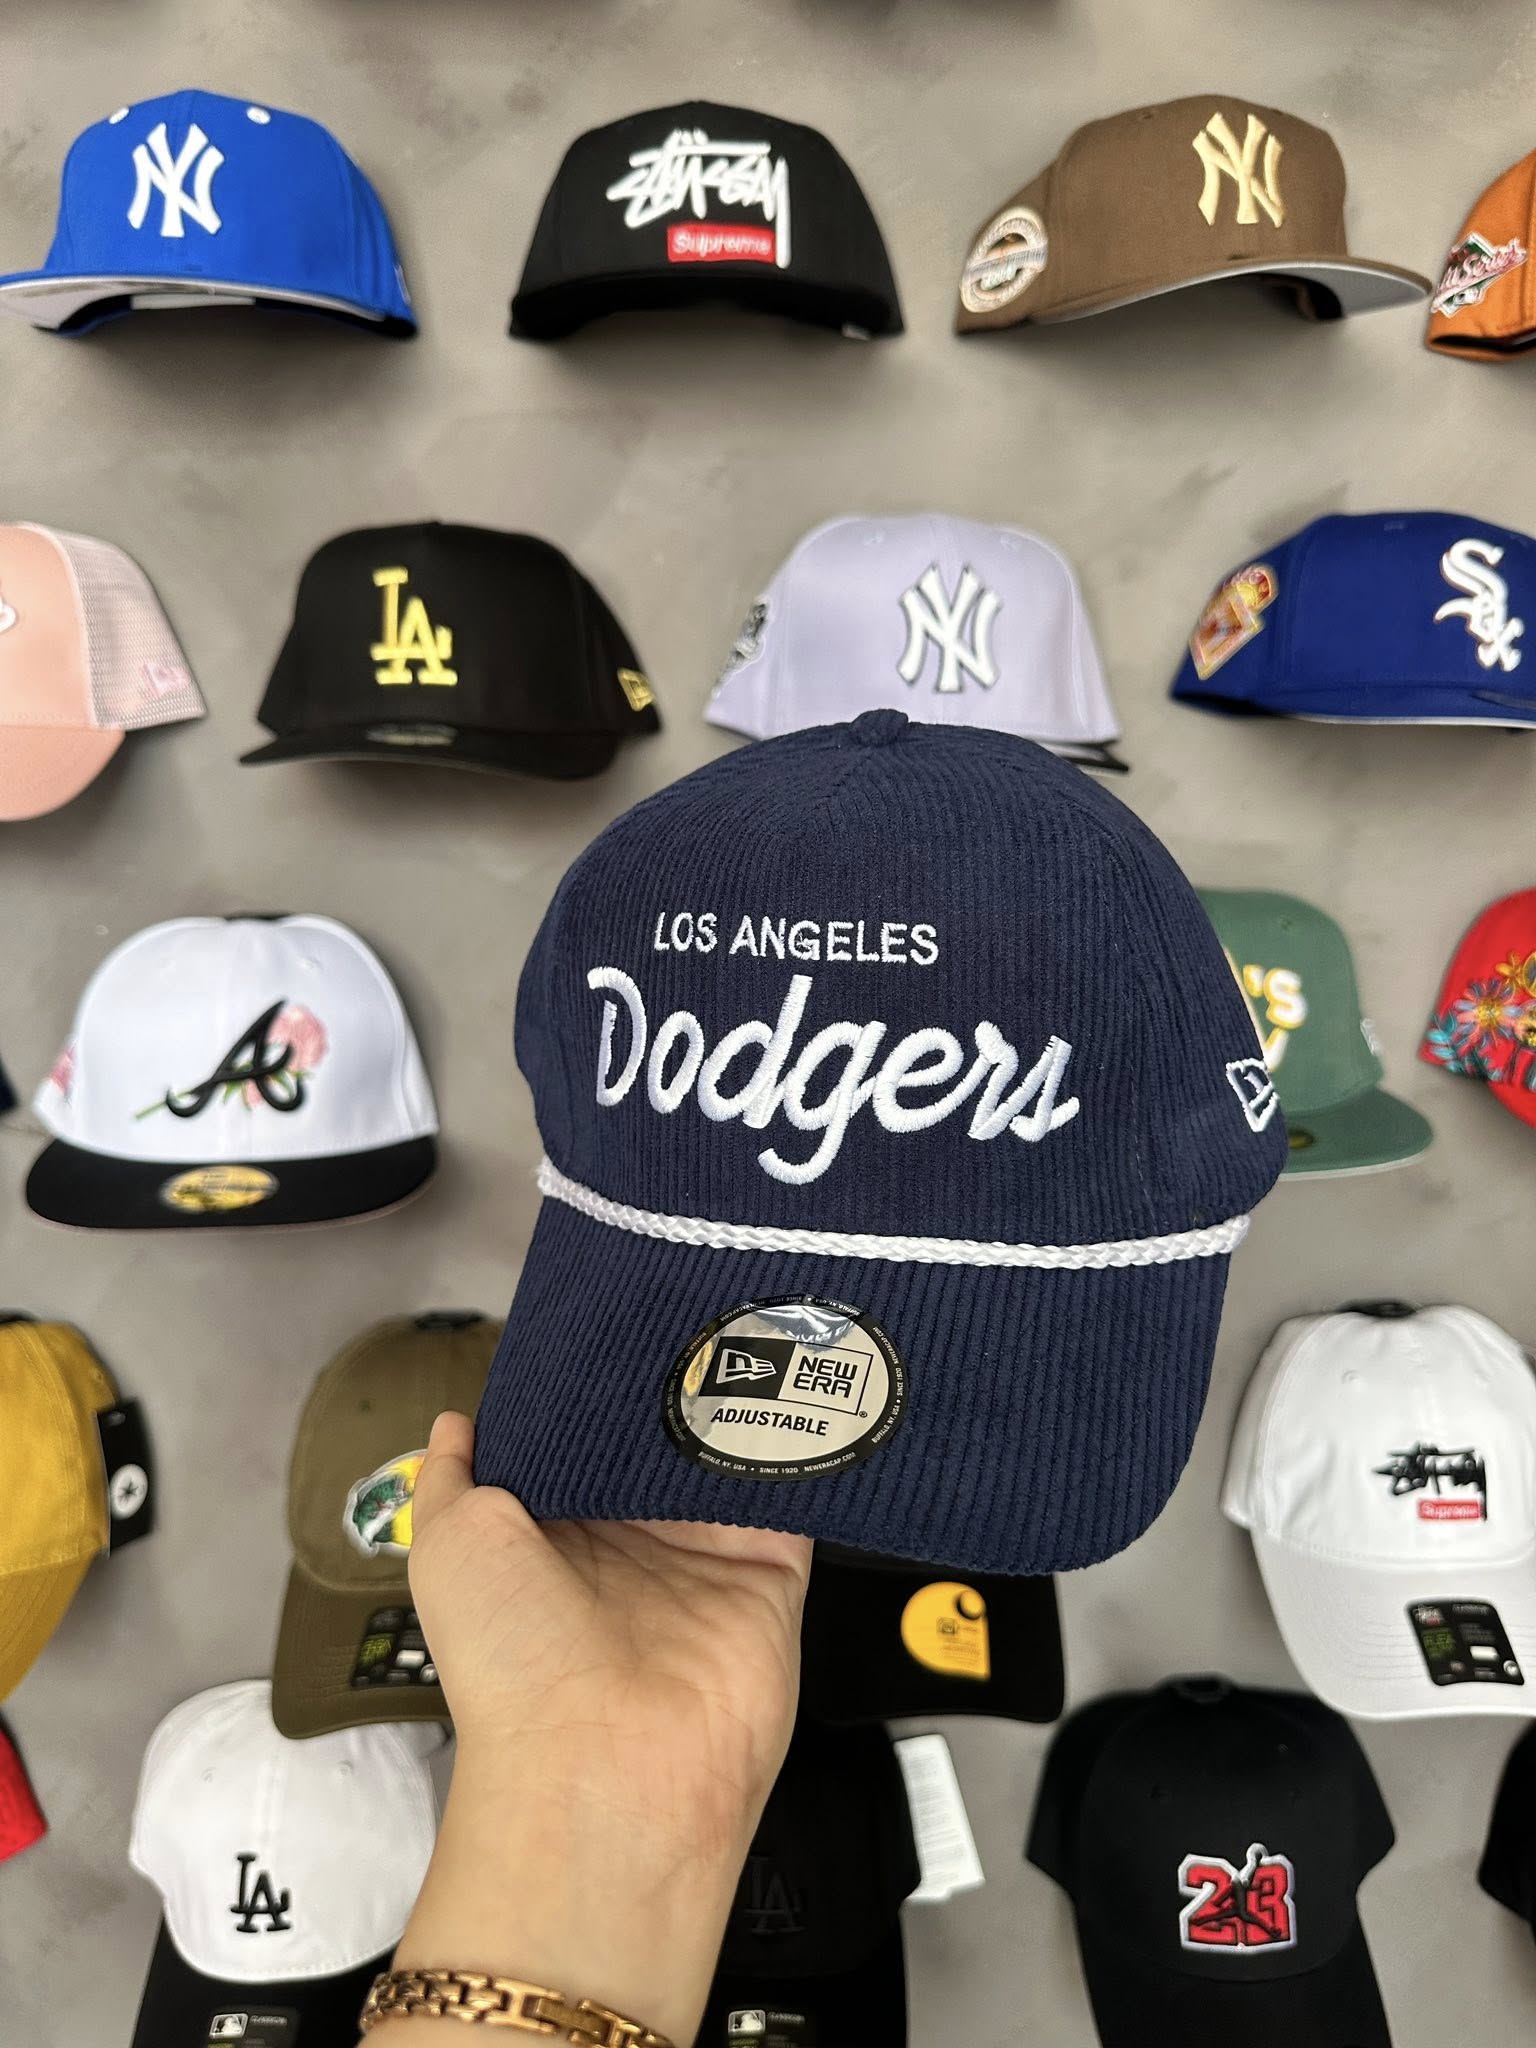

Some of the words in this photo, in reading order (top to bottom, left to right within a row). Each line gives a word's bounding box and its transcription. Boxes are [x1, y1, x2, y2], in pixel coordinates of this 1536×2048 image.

[127, 122, 225, 238] NY
[1192, 111, 1284, 227] NY
[673, 231, 770, 257] Supreme
[370, 567, 458, 685] LA
[898, 562, 1001, 693] NY
[653, 912, 717, 953] LOS
[729, 915, 939, 966] ANGELES
[587, 966, 1080, 1185] Dodgers
[793, 1374, 852, 1398] ERA
[799, 1355, 858, 1381] NEW
[895, 1367, 904, 1380] 1920
[896, 1381, 904, 1397] SINCE
[711, 1408, 829, 1436] ADJUSTABLE
[230, 1851, 292, 1933] LA
